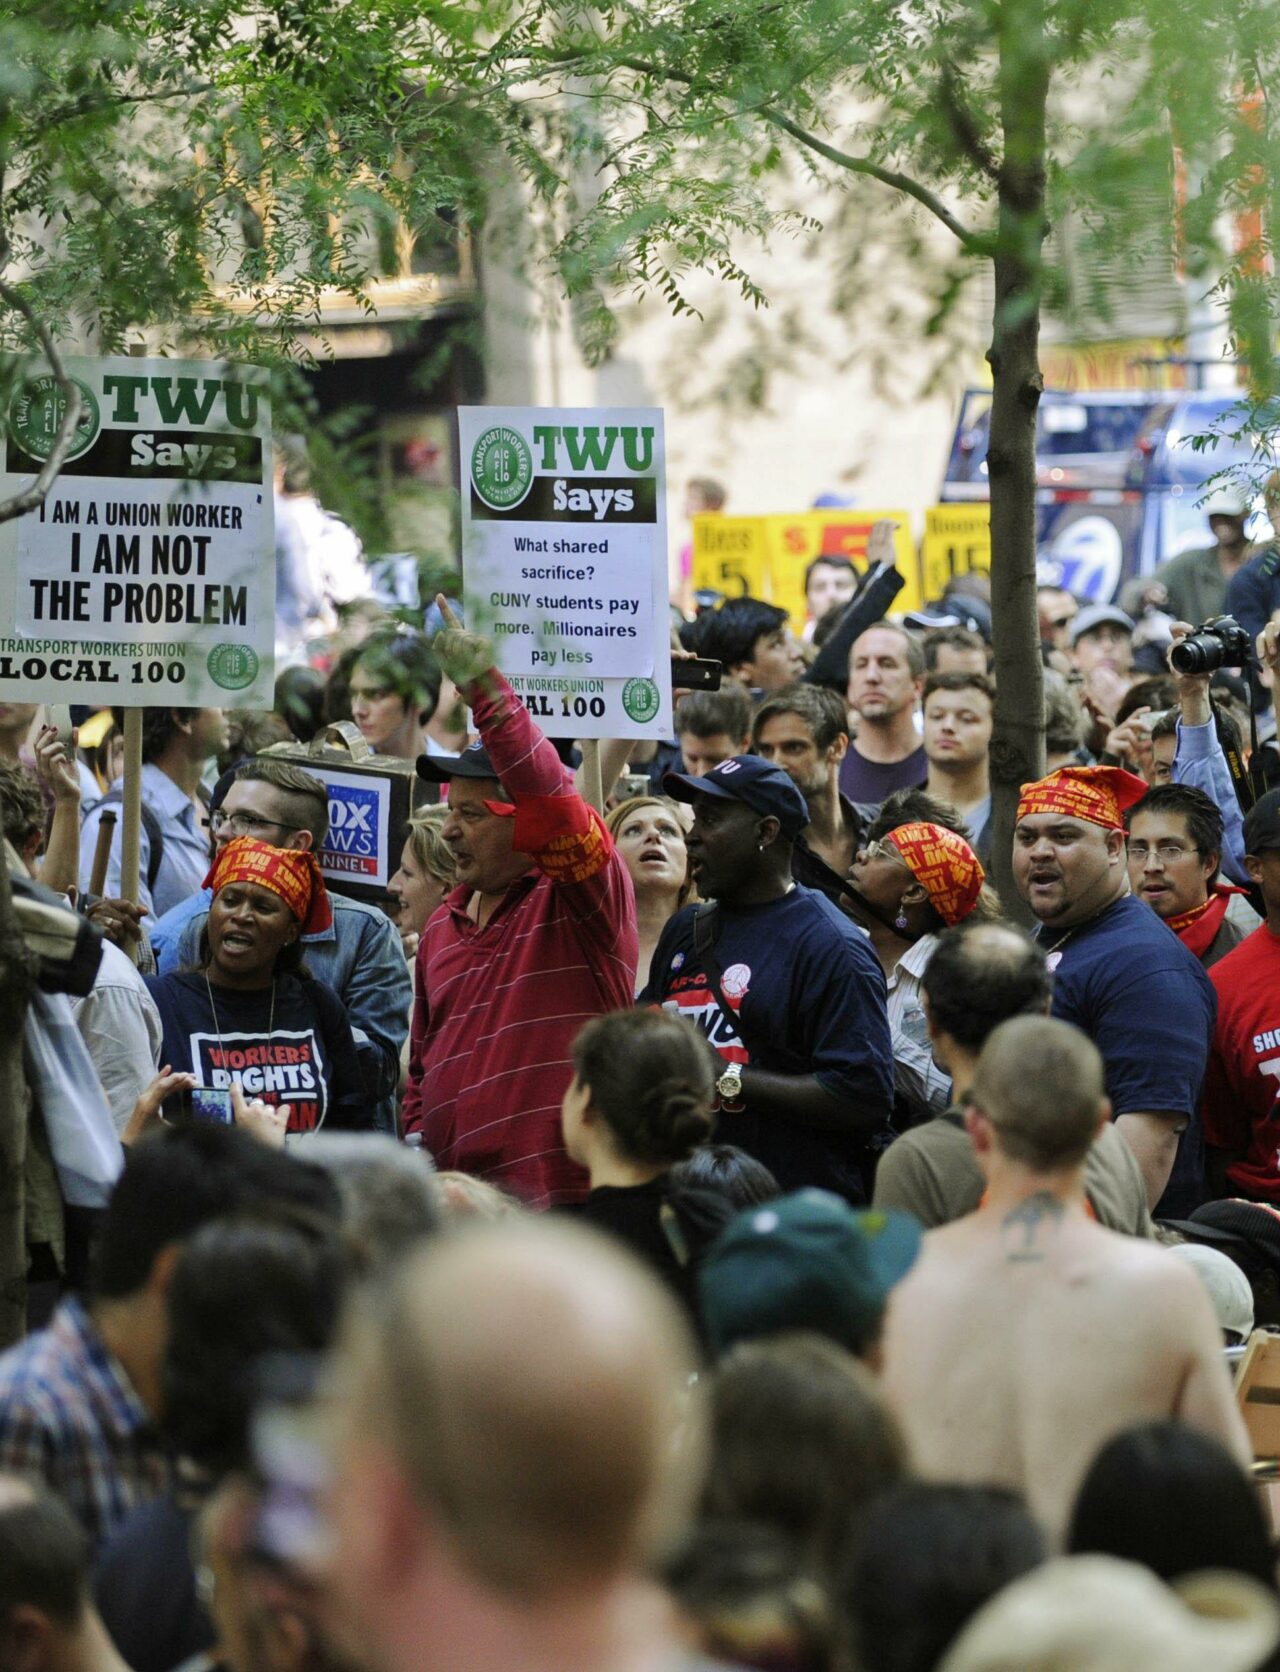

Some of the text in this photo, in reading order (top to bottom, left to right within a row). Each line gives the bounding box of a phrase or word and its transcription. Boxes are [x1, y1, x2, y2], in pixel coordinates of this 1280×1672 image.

[103, 375, 262, 429] TWU
[130, 433, 237, 476] Says
[476, 429, 528, 480] TRANSPORT WORKERS
[533, 426, 655, 472] TWU
[553, 479, 635, 520] Says
[39, 500, 243, 530] I AM A UNION WORKER
[71, 532, 211, 575] I AM NOT
[514, 537, 609, 554] What shared
[521, 565, 595, 580] sacrifice?
[30, 579, 248, 626] THE PROBLEM
[490, 592, 640, 615] CUNY students pay
[494, 620, 637, 637] more. Millionaires
[0, 638, 187, 658] TRANSPORT WORKERS UNION
[531, 649, 593, 666] pay less
[0, 657, 119, 683] LOCAL
[131, 661, 186, 684] 100
[527, 678, 569, 692] WORKERS
[571, 679, 604, 693] UNION
[561, 697, 606, 717] 100
[1228, 751, 1241, 779] Nikon
[327, 799, 372, 832] OX
[322, 854, 369, 873] NNEL
[208, 1043, 311, 1069] WORKERS
[212, 1062, 316, 1095] RIGHTS
